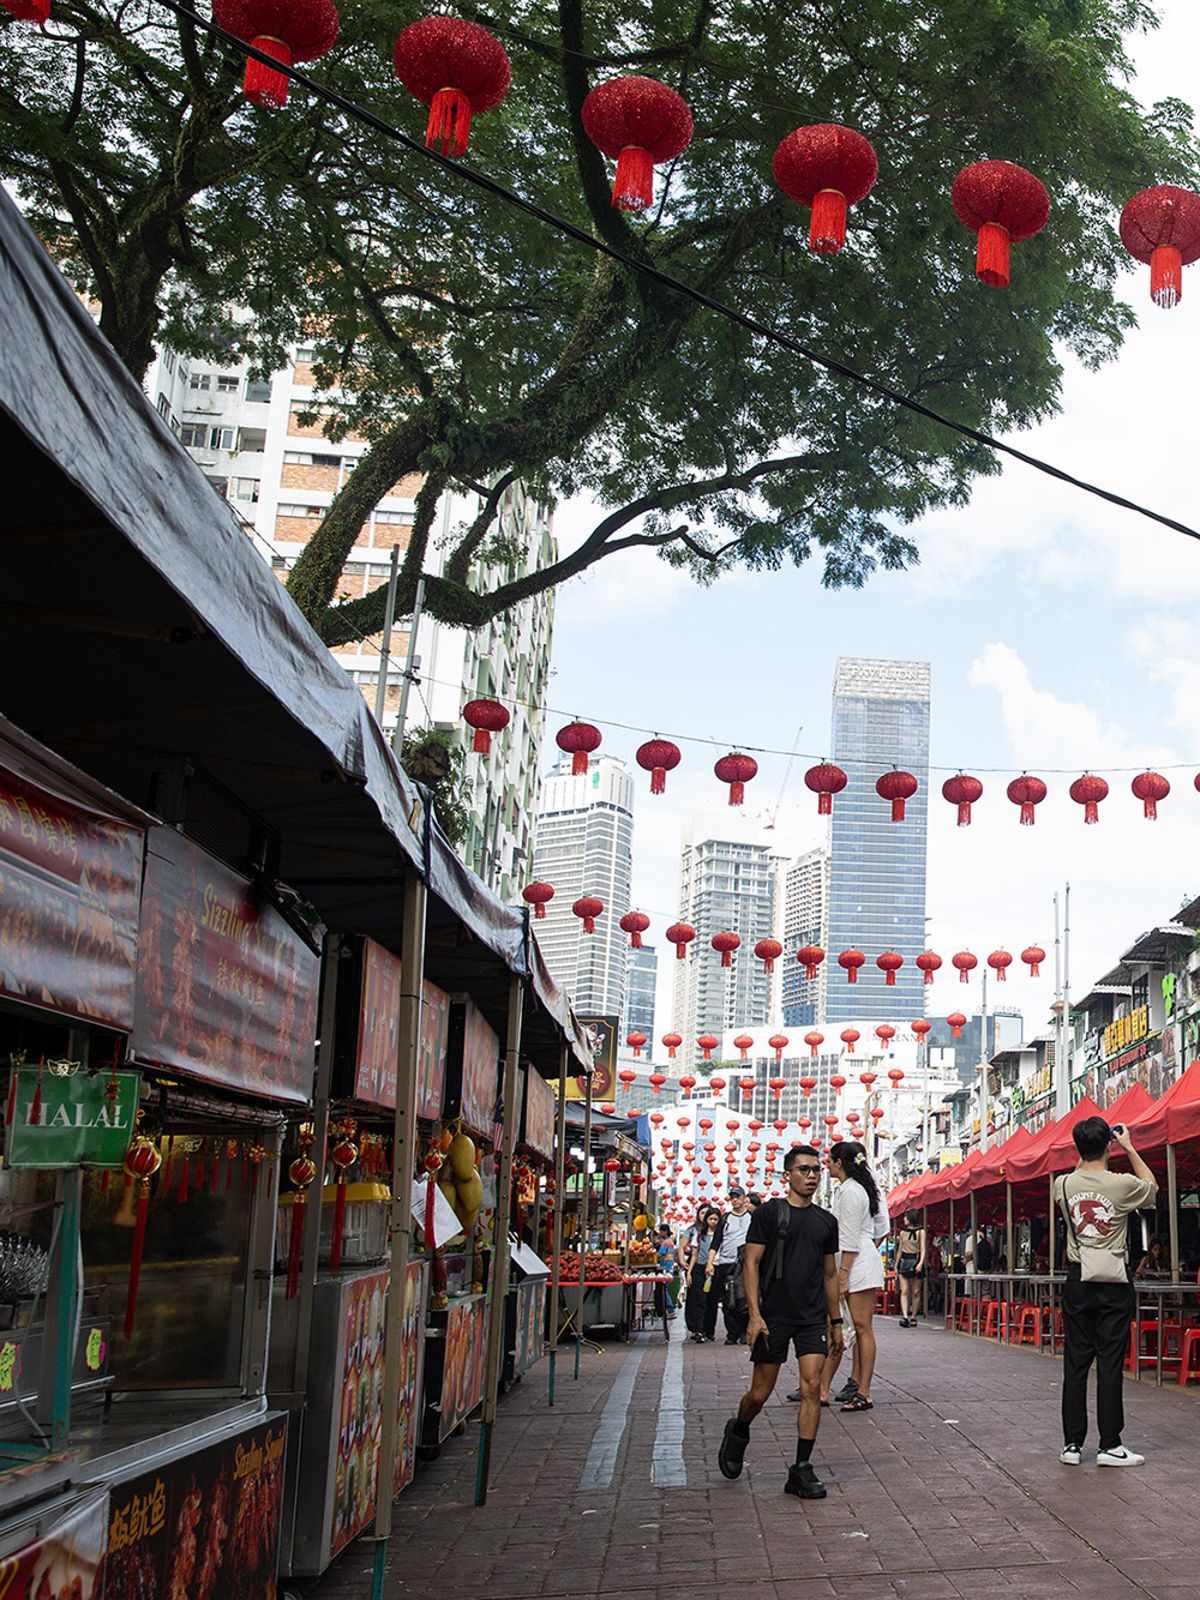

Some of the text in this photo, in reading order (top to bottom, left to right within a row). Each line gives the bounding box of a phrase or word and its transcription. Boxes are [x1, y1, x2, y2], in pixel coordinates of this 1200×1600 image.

[850, 665, 919, 682] PAVILION
[201, 882, 250, 960] Sizzling
[25, 1102, 129, 1129] HALAL
[1067, 1191, 1095, 1206] MOUNT
